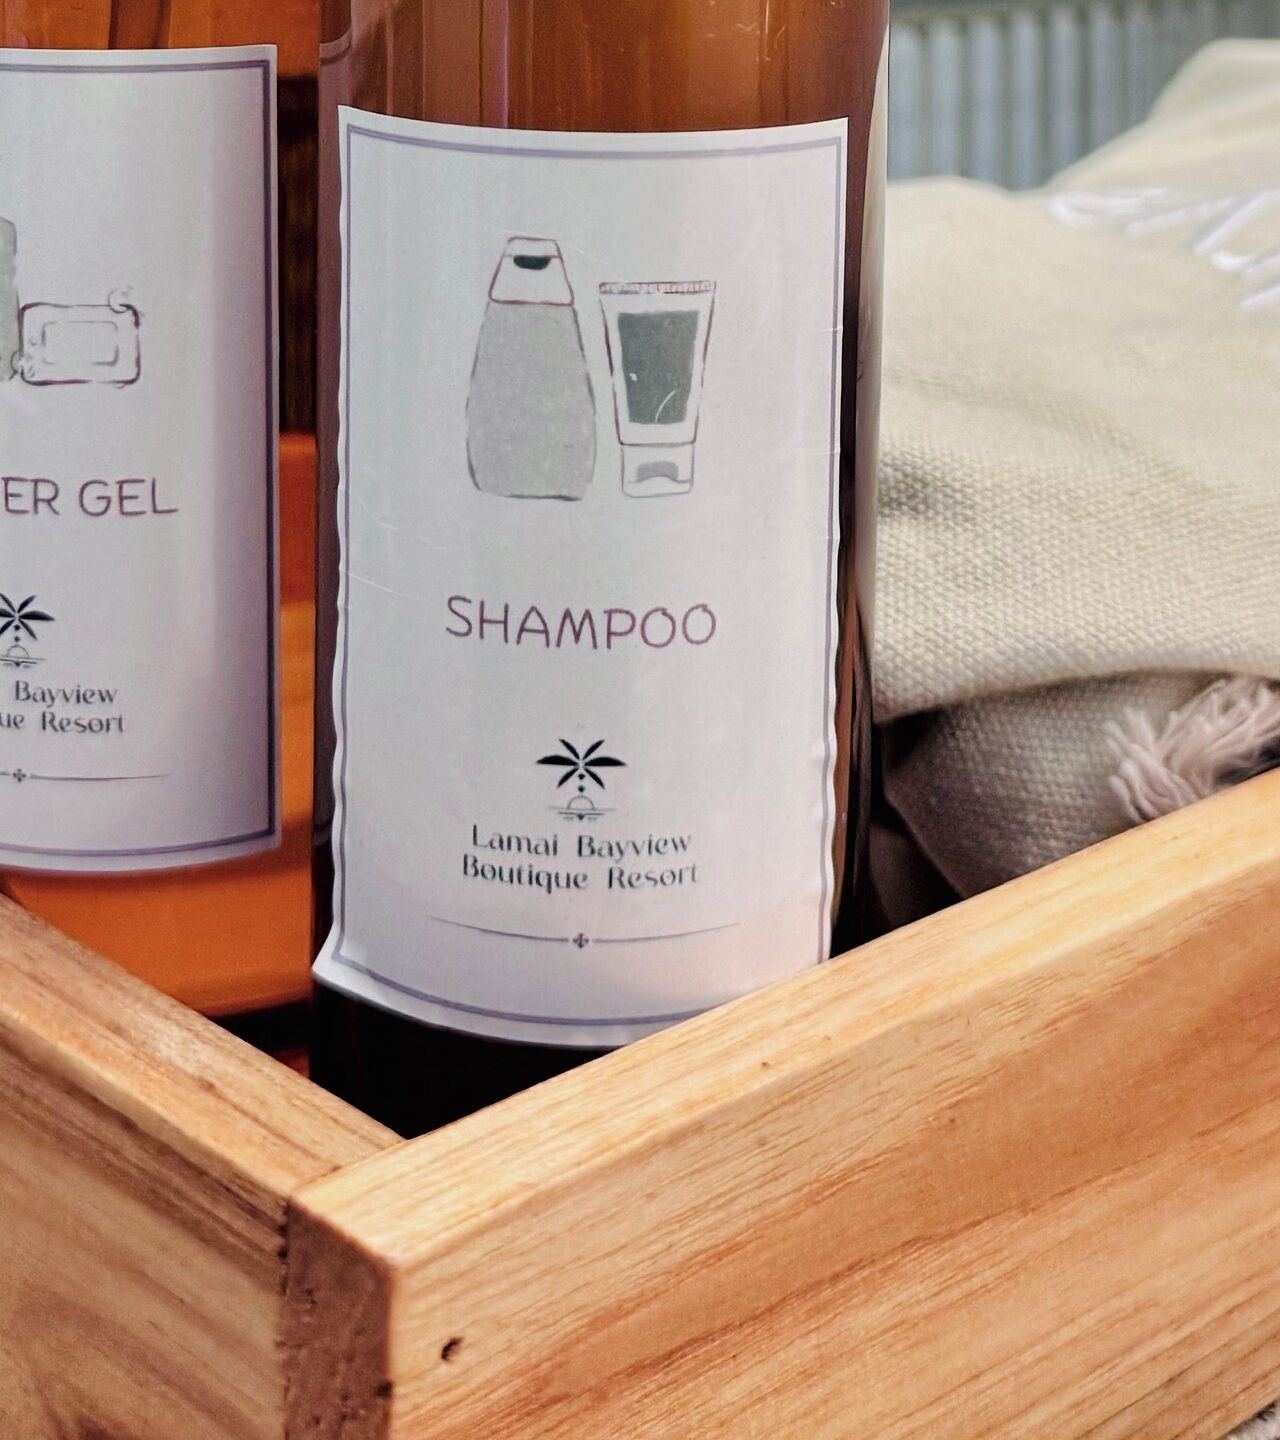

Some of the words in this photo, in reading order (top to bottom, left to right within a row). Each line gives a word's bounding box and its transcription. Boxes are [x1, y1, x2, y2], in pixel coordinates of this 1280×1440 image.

[78, 477, 180, 517] GEL
[445, 594, 718, 651] SHAMPOO
[14, 679, 118, 708] Bayview
[41, 710, 125, 734] Resort
[472, 824, 558, 857] Lamai
[577, 833, 693, 863] Bayview
[463, 853, 589, 894] Boutique
[607, 862, 699, 890] Resort
